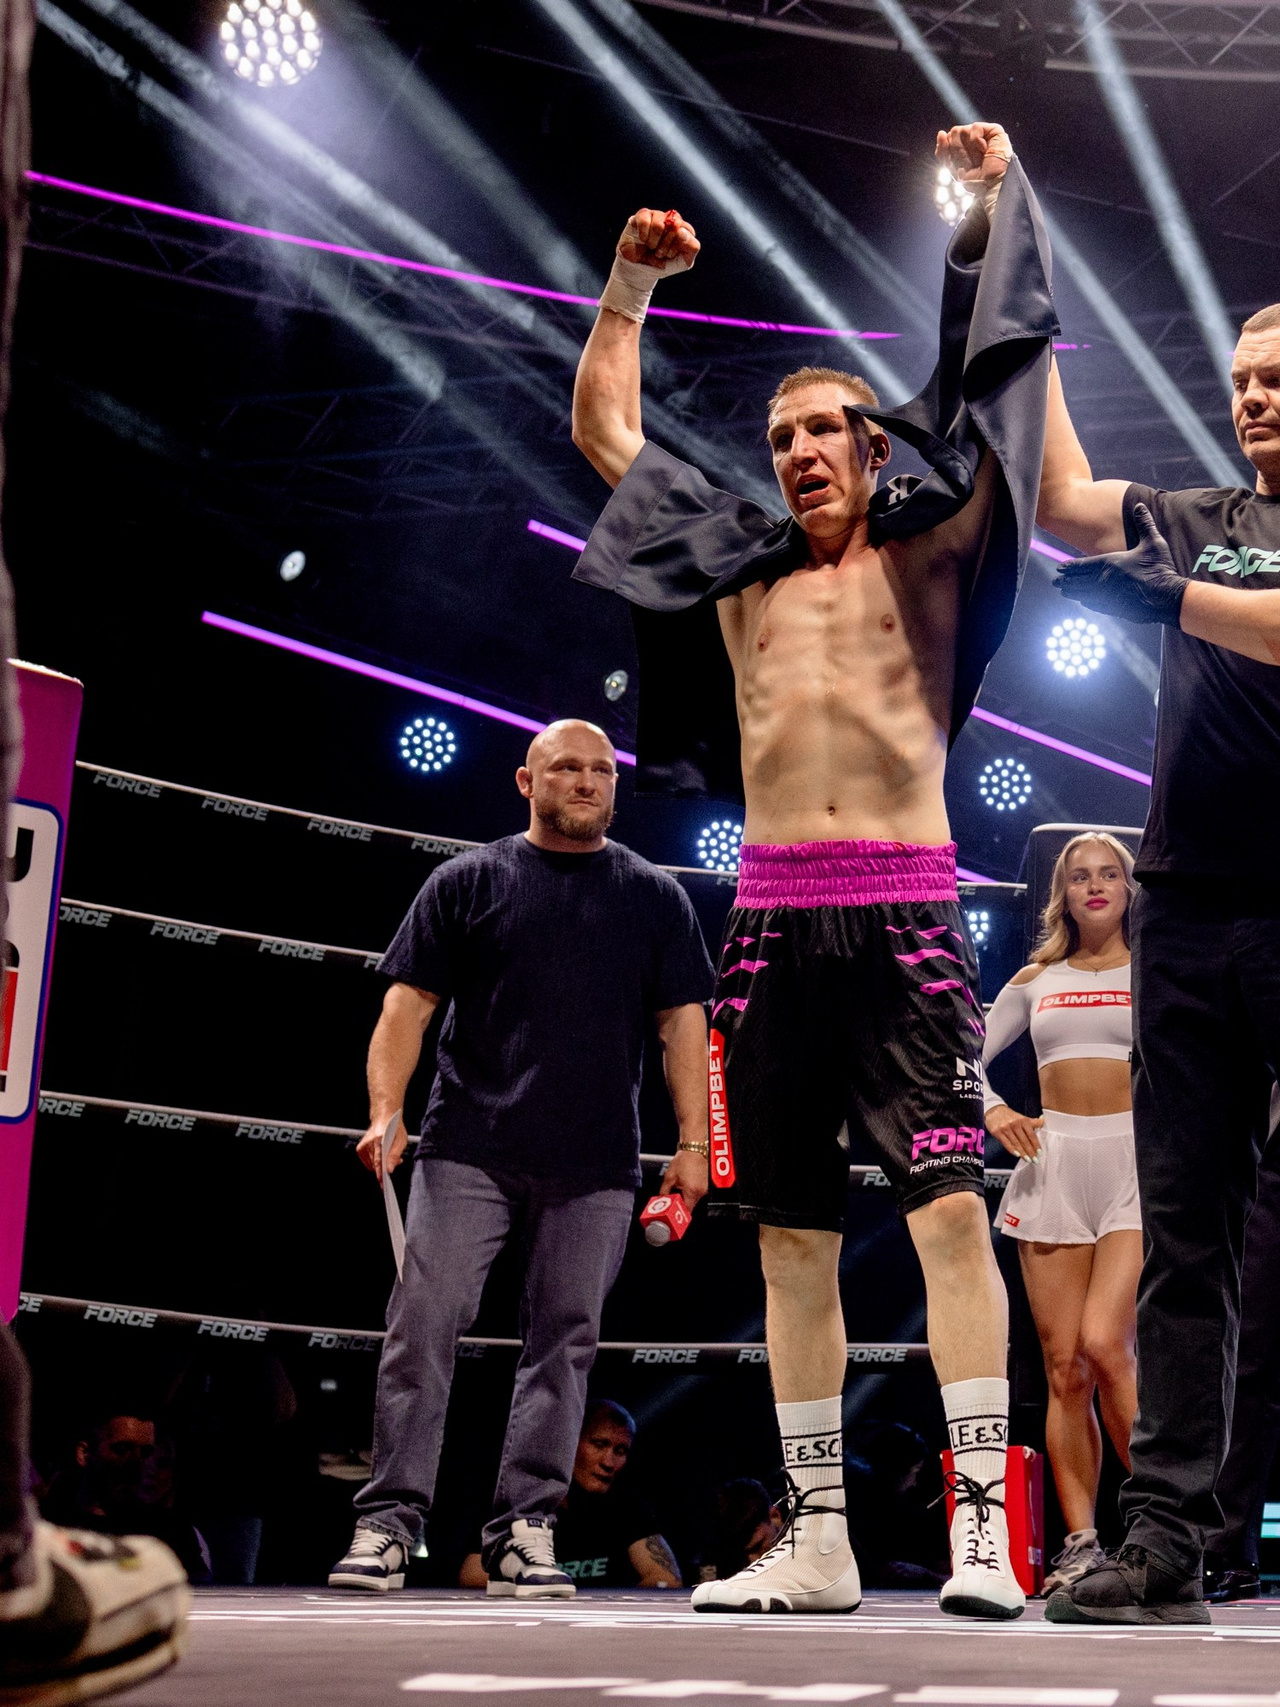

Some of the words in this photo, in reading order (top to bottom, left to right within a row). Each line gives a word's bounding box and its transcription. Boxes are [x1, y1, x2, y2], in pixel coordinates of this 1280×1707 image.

[94, 772, 162, 798] FORCE
[202, 797, 269, 821] FORCE
[307, 818, 374, 842] FORCE
[59, 906, 112, 928] ORCE
[151, 921, 221, 946] FORCE
[258, 940, 326, 962] FORCE
[952, 1080, 983, 1092] SPO
[38, 1097, 86, 1118] RCE
[709, 1041, 730, 1177] OLIMPBET
[125, 1109, 196, 1131] FORCE
[235, 1123, 305, 1144] FORCE
[911, 1126, 984, 1162] FORC
[909, 1156, 950, 1175] FIGHTING
[84, 1304, 157, 1328] FORCE
[198, 1320, 270, 1342] FORCE
[633, 1349, 699, 1364] FORCE
[555, 1557, 609, 1578] RCE
